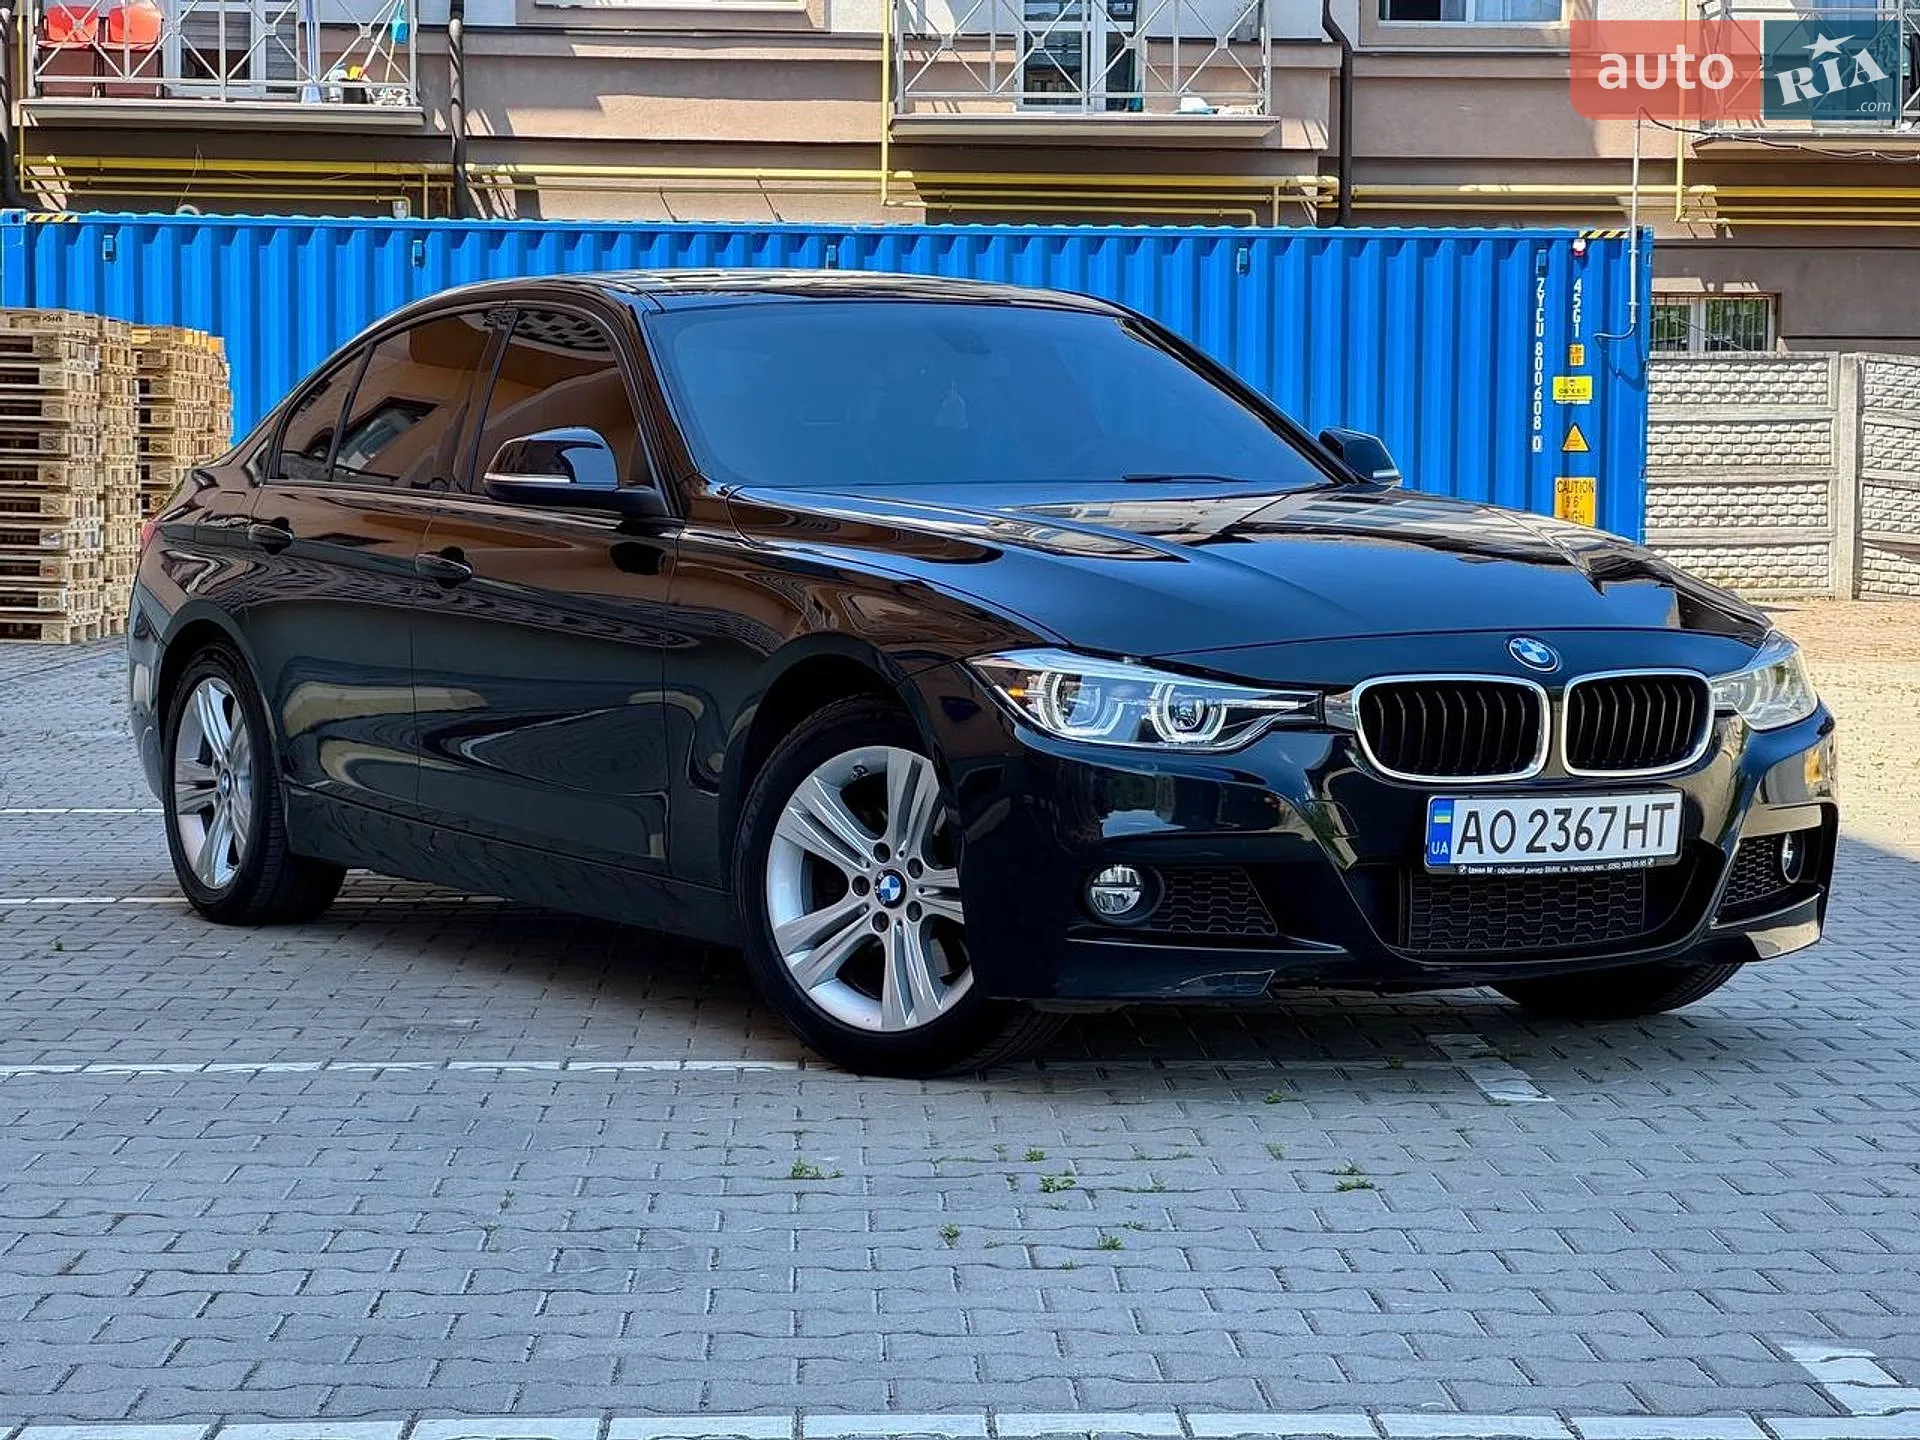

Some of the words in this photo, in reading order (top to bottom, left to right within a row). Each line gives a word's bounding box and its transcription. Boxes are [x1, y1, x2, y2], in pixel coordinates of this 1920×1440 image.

[1535, 277, 1546, 337] ZYCU
[1572, 278, 1583, 338] 45G1
[1533, 341, 1544, 431] 800608
[1557, 480, 1594, 494] CAUTION
[1431, 841, 1449, 855] UA
[1456, 809, 1517, 854] AO
[1525, 805, 1617, 854] 2367
[1623, 803, 1675, 850] HT
